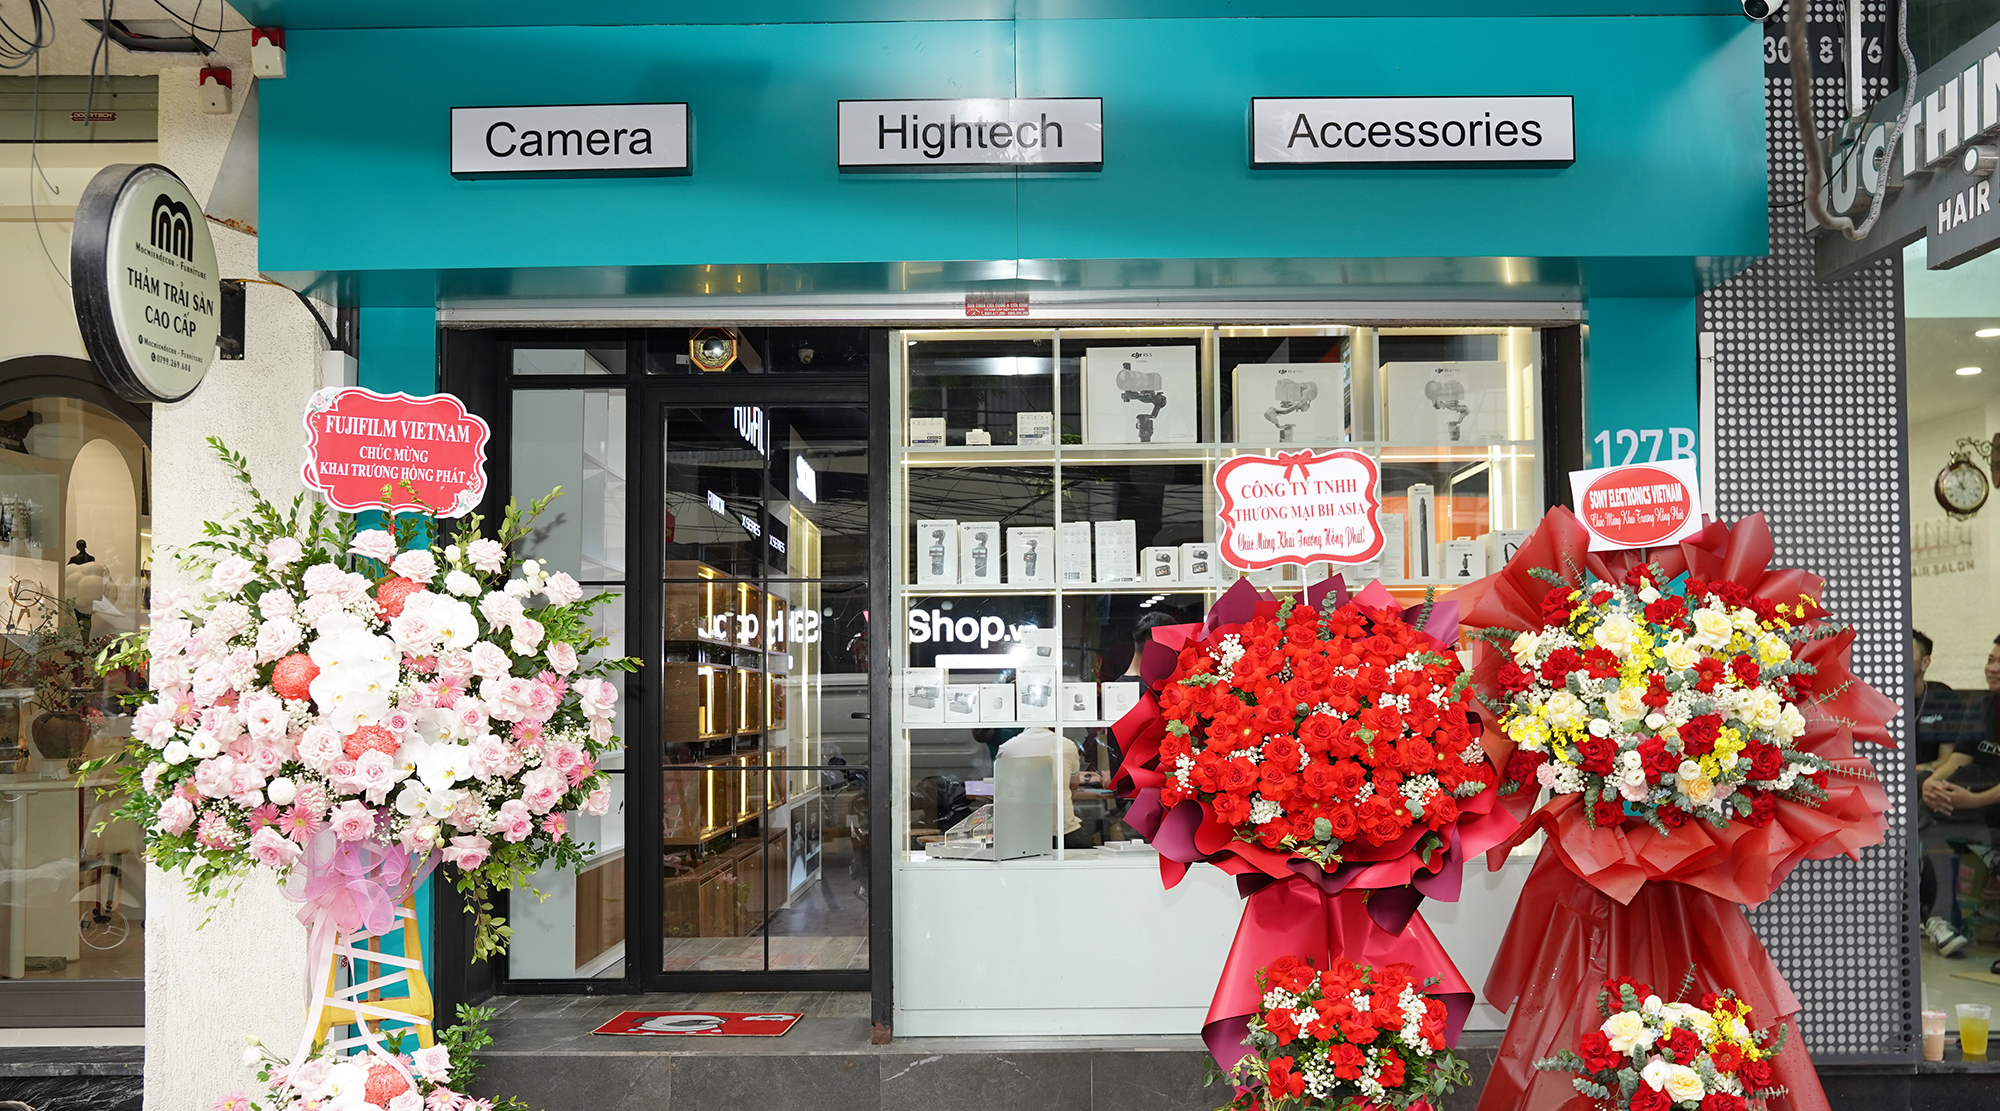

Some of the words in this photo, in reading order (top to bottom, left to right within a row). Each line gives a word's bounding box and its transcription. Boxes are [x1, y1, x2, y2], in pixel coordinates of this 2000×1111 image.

[486, 121, 653, 157] Camera
[879, 114, 1063, 157] Hightech
[1287, 111, 1543, 149] Accessories
[1937, 180, 1991, 235] HAIR
[127, 267, 160, 297] THẢM
[163, 281, 189, 308] TRẢI
[193, 291, 214, 317] SÀN
[145, 305, 170, 329] CAO
[174, 312, 197, 338] CẤP
[325, 415, 398, 438] FUJIFILM
[400, 420, 470, 443] VIETNAM
[359, 443, 392, 461] CHÚC
[394, 445, 429, 463] MỪNG
[1594, 427, 1698, 469] 127B
[320, 462, 349, 476] KHAI
[351, 464, 399, 480] TRƯƠNG
[435, 467, 466, 484] PHÁT
[1241, 480, 1286, 499] CÔNG
[1289, 481, 1310, 496] TY
[1313, 479, 1358, 495] TNHH
[1589, 490, 1608, 509] SONY
[1608, 485, 1652, 508] ELECTRONICS
[1651, 483, 1683, 504] VIETNAM
[1234, 505, 1289, 522] THƯƠNG
[1291, 504, 1314, 522] MẠI
[1318, 503, 1335, 518] BH
[1337, 502, 1366, 516] ASIA
[1277, 530, 1295, 549] Khai
[1931, 560, 1976, 576] SALON
[908, 608, 1039, 649] Shop.v
